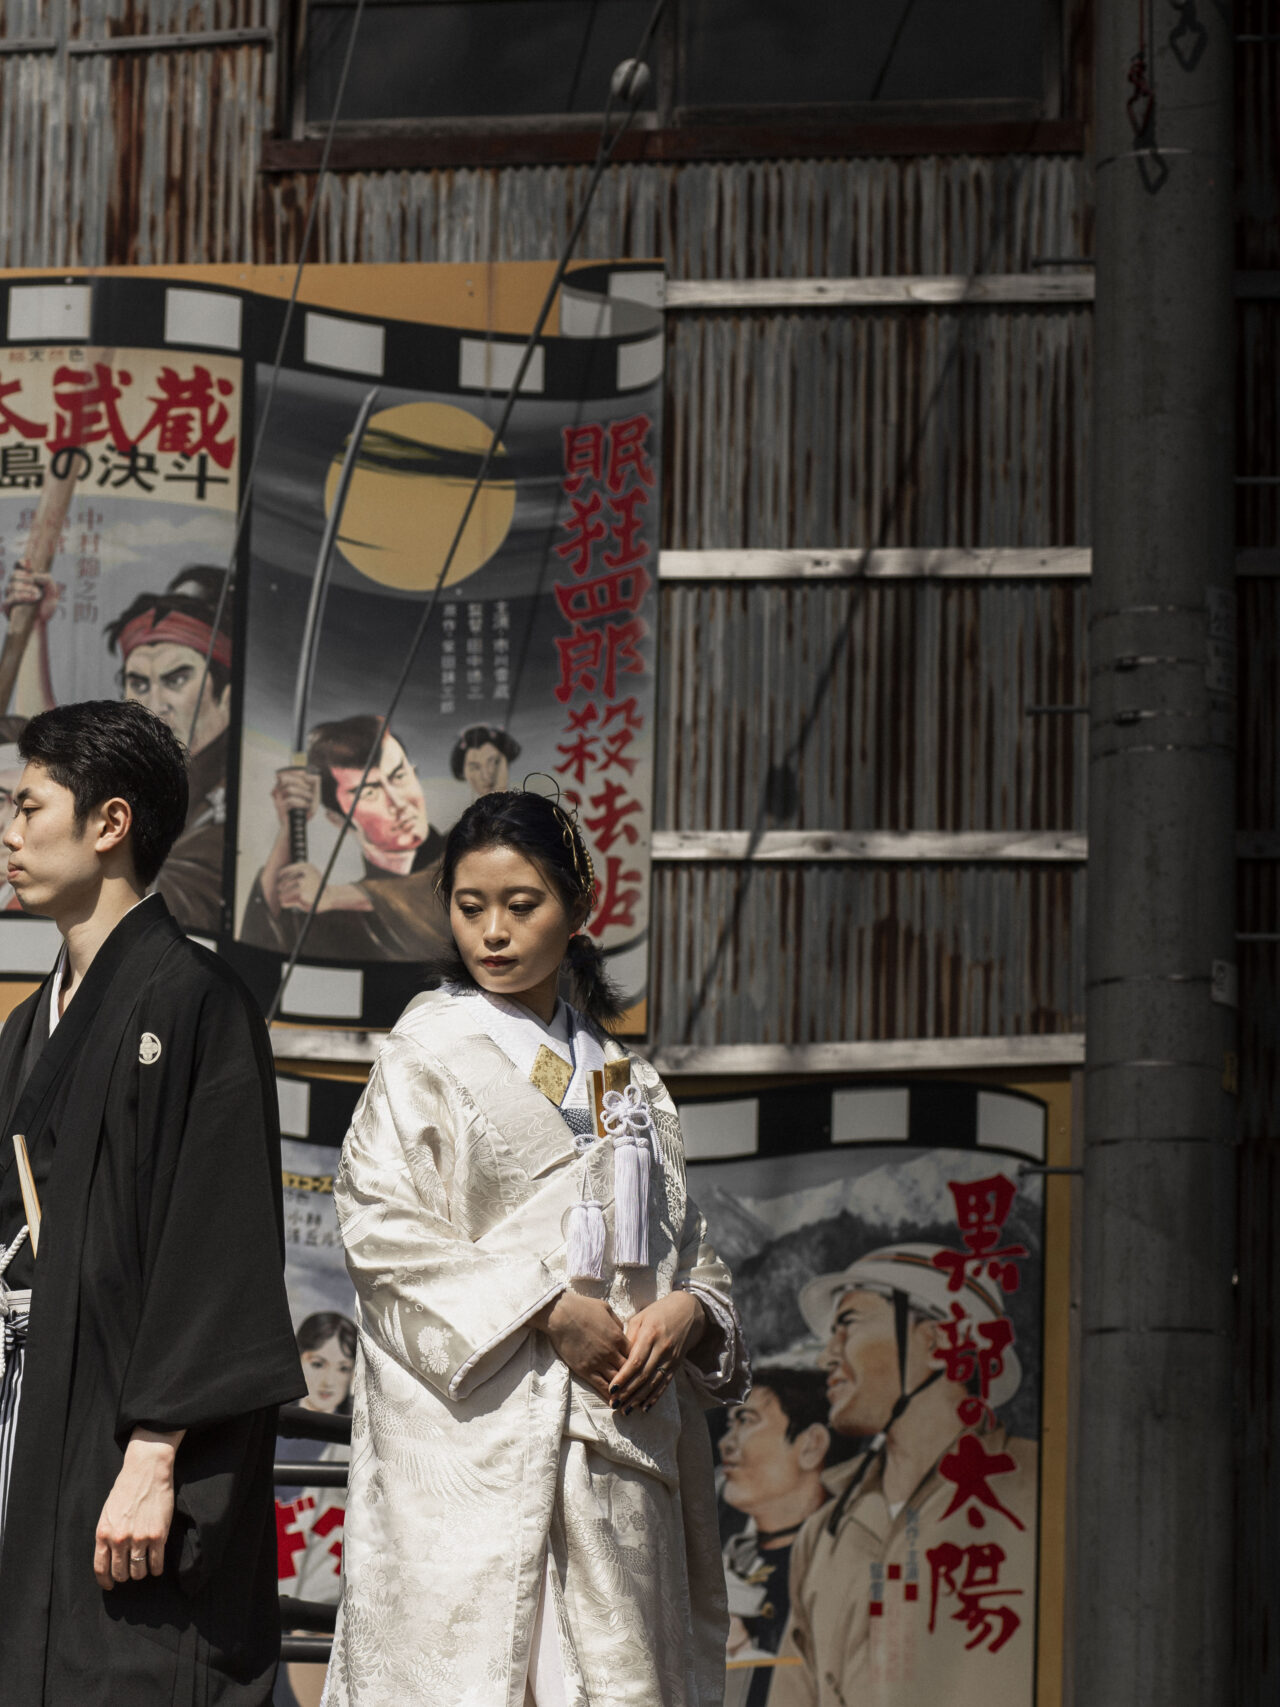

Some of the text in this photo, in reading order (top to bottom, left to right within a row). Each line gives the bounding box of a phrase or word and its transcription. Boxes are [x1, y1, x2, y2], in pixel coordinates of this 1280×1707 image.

[926, 1172, 1029, 1654] 黒部の太陽
